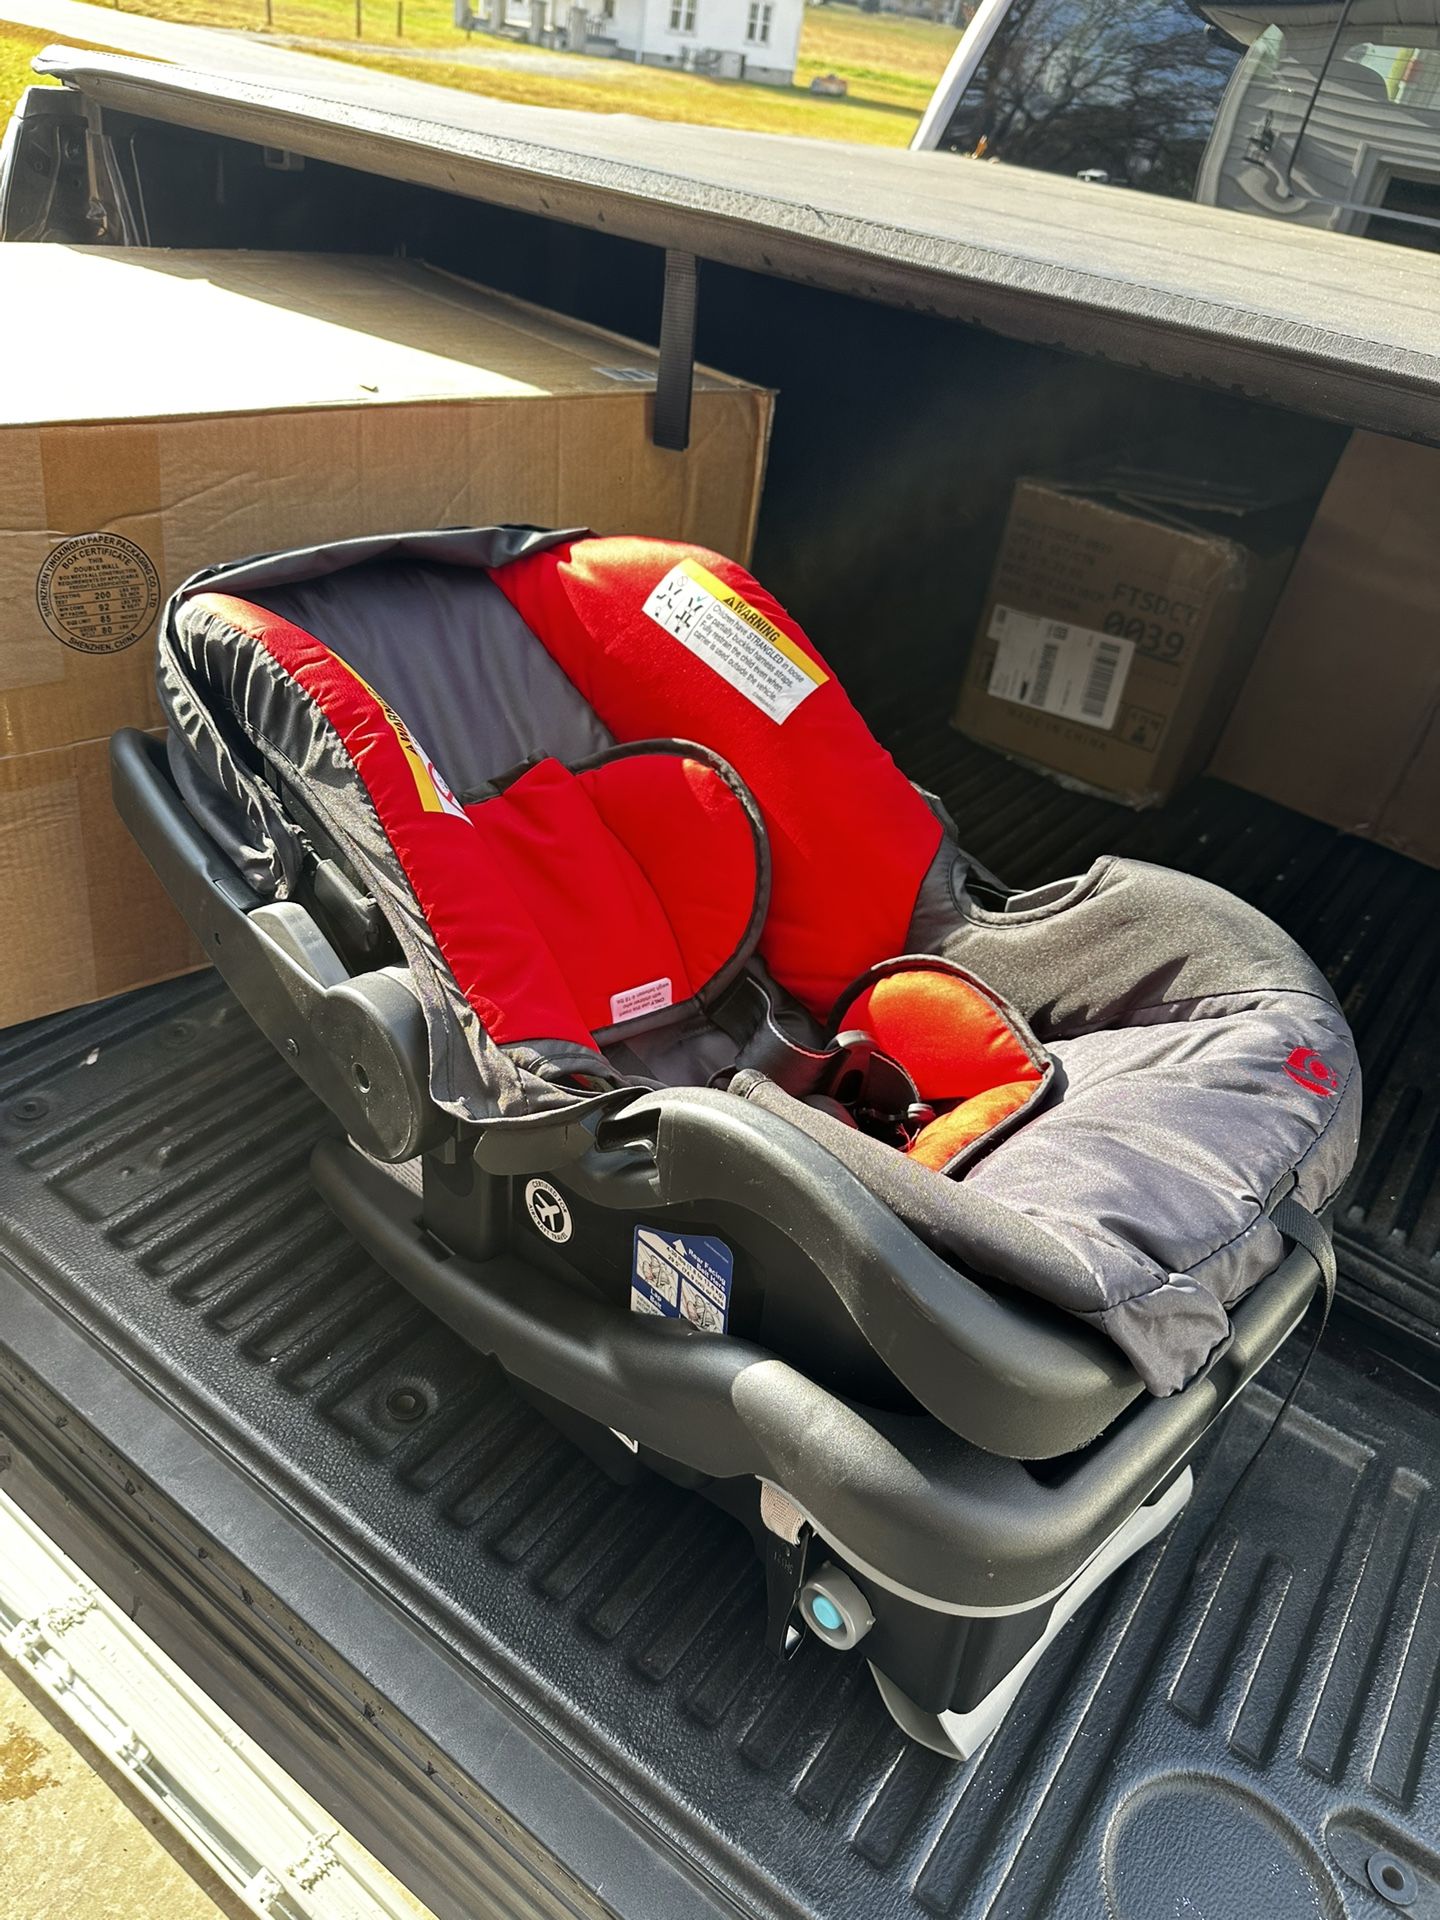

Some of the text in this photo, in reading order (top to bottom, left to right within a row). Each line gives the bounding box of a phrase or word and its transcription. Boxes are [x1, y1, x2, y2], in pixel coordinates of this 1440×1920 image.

[41, 571, 53, 618] SHENZHEN
[87, 535, 115, 546] PAPER
[116, 540, 153, 575] PACKAGING
[62, 548, 132, 570] BOX CERTIFICATE
[74, 565, 100, 573] DOUBLE
[95, 591, 111, 600] 200
[98, 604, 110, 612] 92
[1112, 582, 1201, 625] FTSDCT
[100, 614, 112, 623] 85
[102, 626, 112, 634] 80
[734, 600, 780, 642] WARNING
[1104, 610, 1184, 658] 0039
[114, 632, 138, 649] CHINA
[693, 630, 711, 647] carrier
[709, 642, 716, 651] is
[714, 647, 731, 662] used
[727, 656, 748, 677] outside
[746, 671, 758, 685] the
[699, 619, 783, 692] Fully restrain the child even when
[711, 617, 733, 640] partially
[732, 633, 755, 656] buckled
[753, 649, 775, 673] harness
[713, 604, 805, 683] Children have STRANGLED in loose
[532, 1180, 567, 1213] CERTIFIED FOR
[529, 1204, 567, 1240] AIRCRAFT TRAVEL
[688, 1248, 703, 1264] Rear
[704, 1261, 726, 1285] Facing
[651, 1288, 662, 1301] Lap
